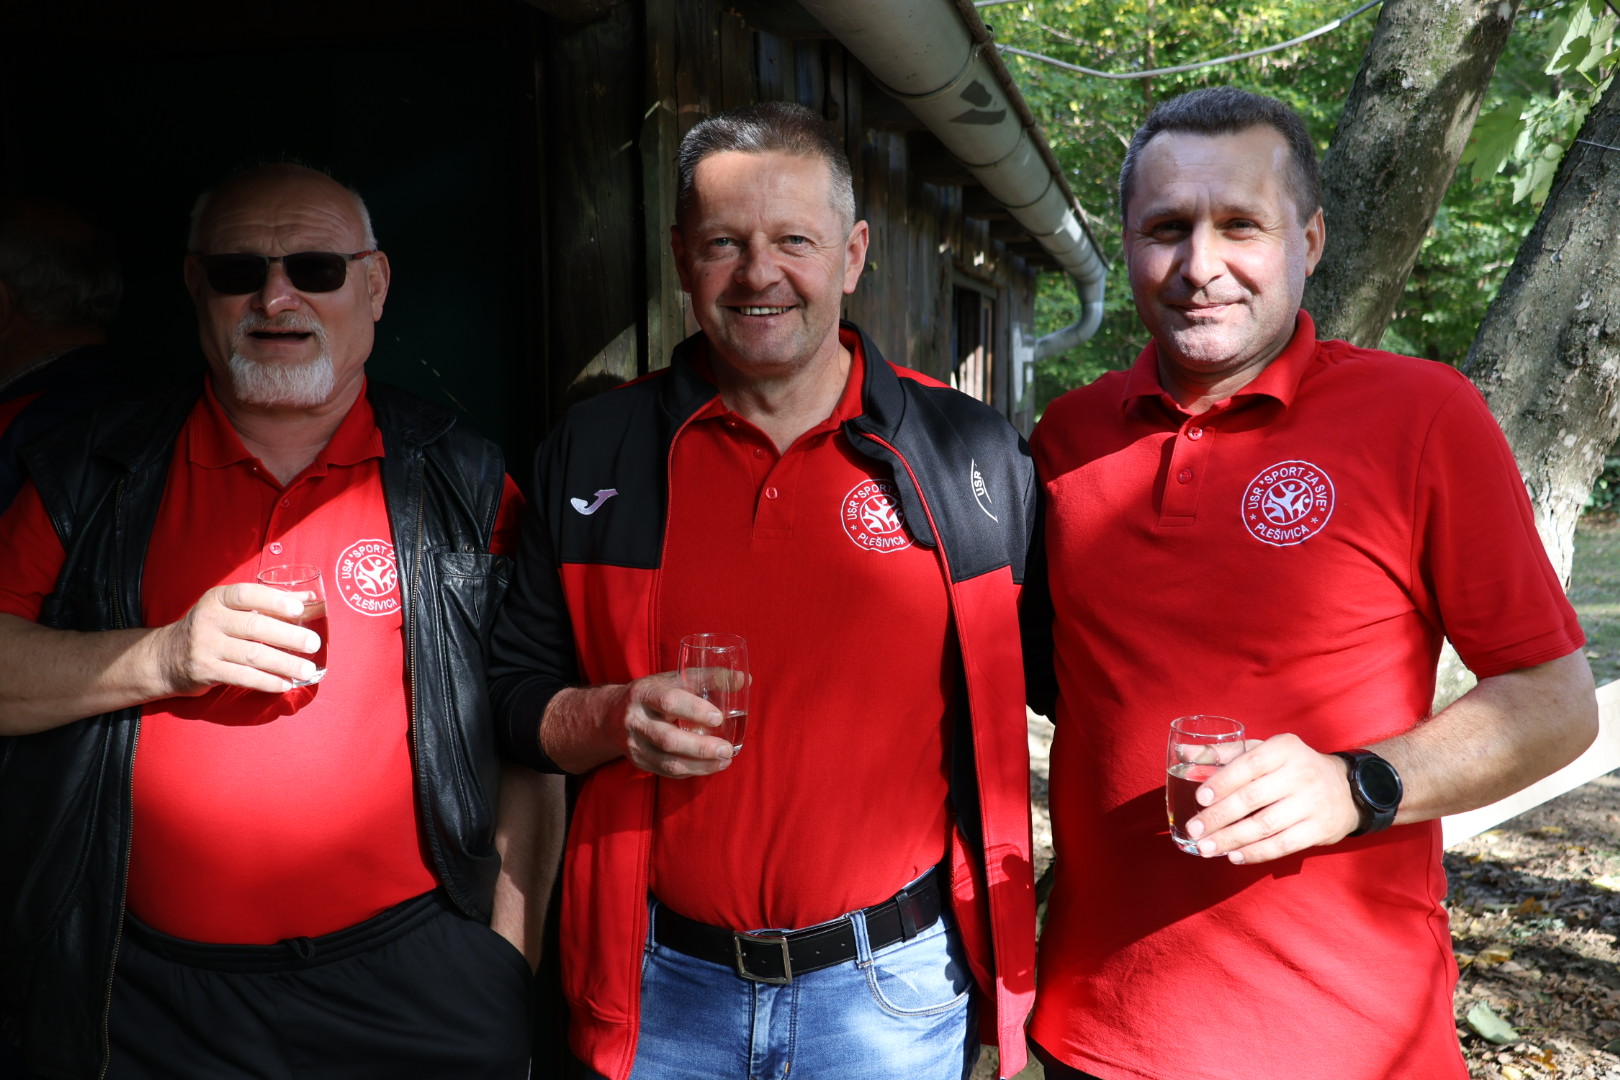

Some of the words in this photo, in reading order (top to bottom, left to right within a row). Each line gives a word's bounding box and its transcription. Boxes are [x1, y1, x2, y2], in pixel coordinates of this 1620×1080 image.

[974, 470, 985, 497] USR
[1247, 487, 1265, 510] USR
[1303, 471, 1320, 486] ZA
[847, 500, 860, 521] USR
[857, 532, 906, 548] PLEŠIVICA
[1254, 522, 1310, 541] PLEŠIVICA
[341, 559, 355, 579] USR
[349, 593, 398, 611] PLEŠIVICA
